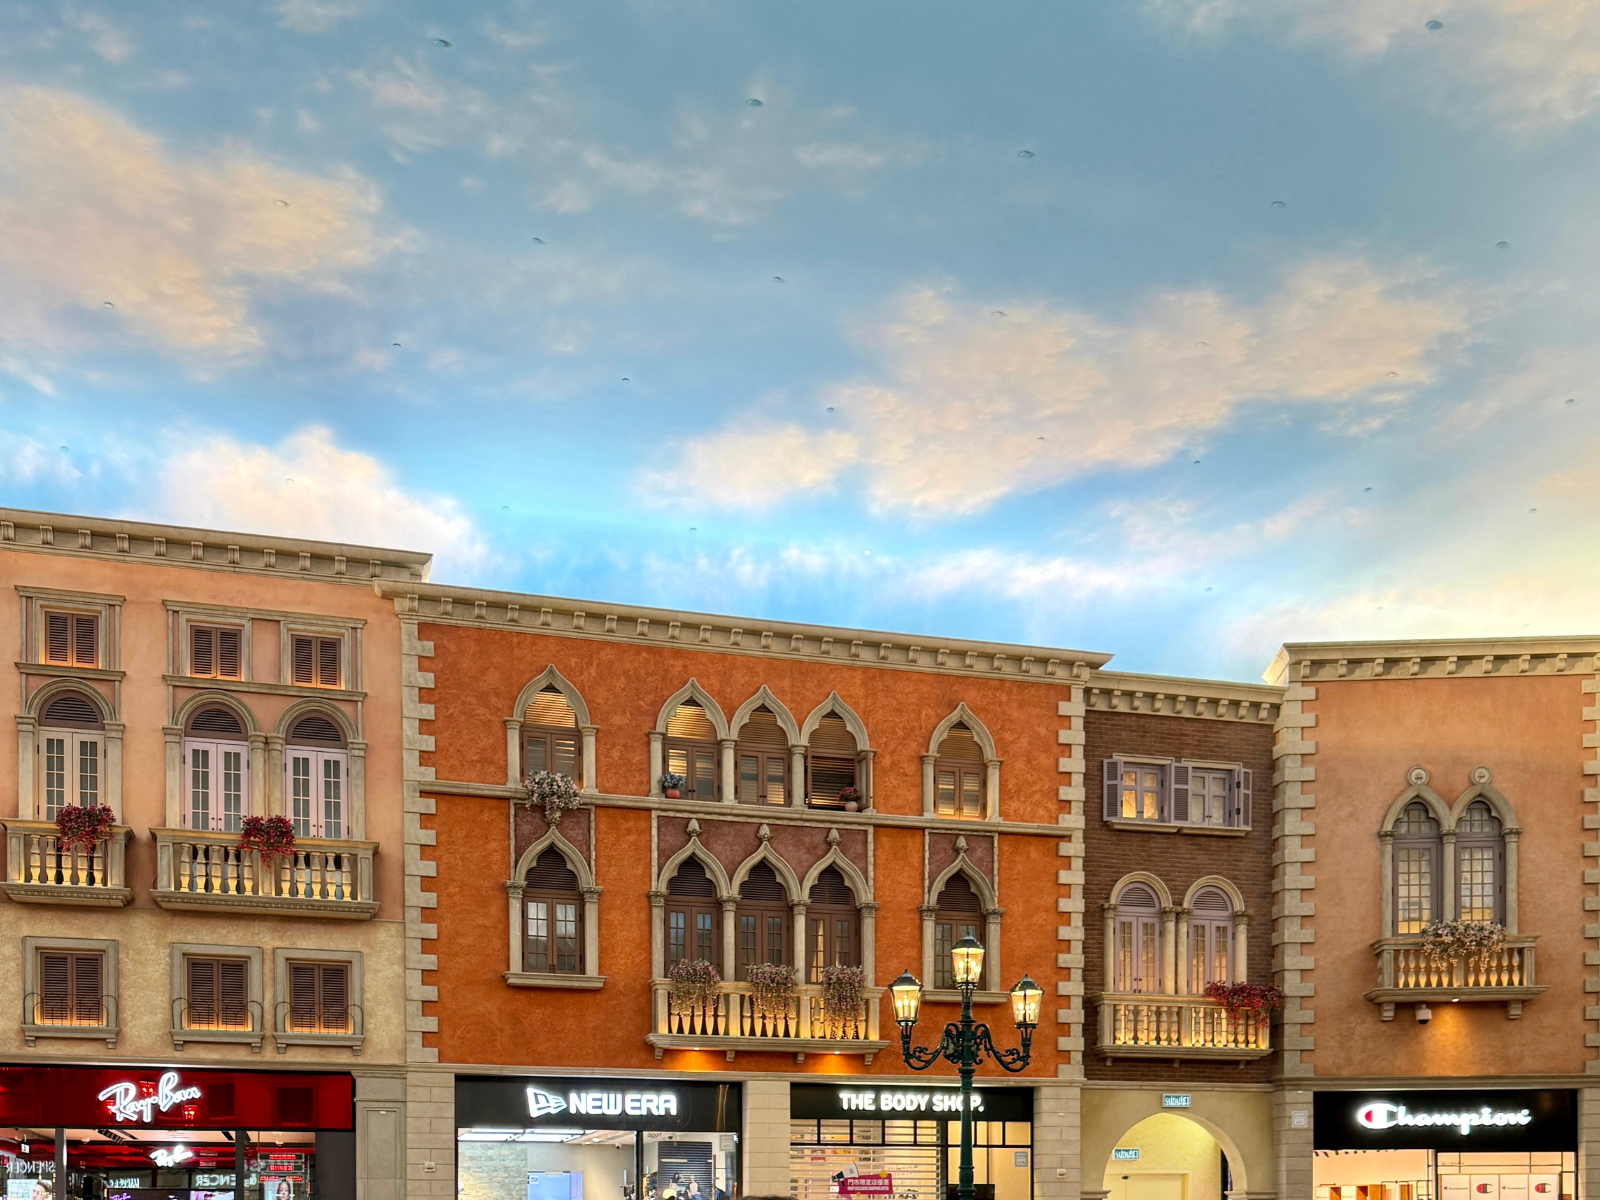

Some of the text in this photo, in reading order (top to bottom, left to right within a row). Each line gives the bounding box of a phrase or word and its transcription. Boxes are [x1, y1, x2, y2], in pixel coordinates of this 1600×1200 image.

[98, 1071, 201, 1122] Ray-Ban
[569, 1092, 677, 1116] NEW ERA
[839, 1093, 876, 1111] THE
[880, 1094, 930, 1112] BODY
[1357, 1102, 1532, 1136] Champion
